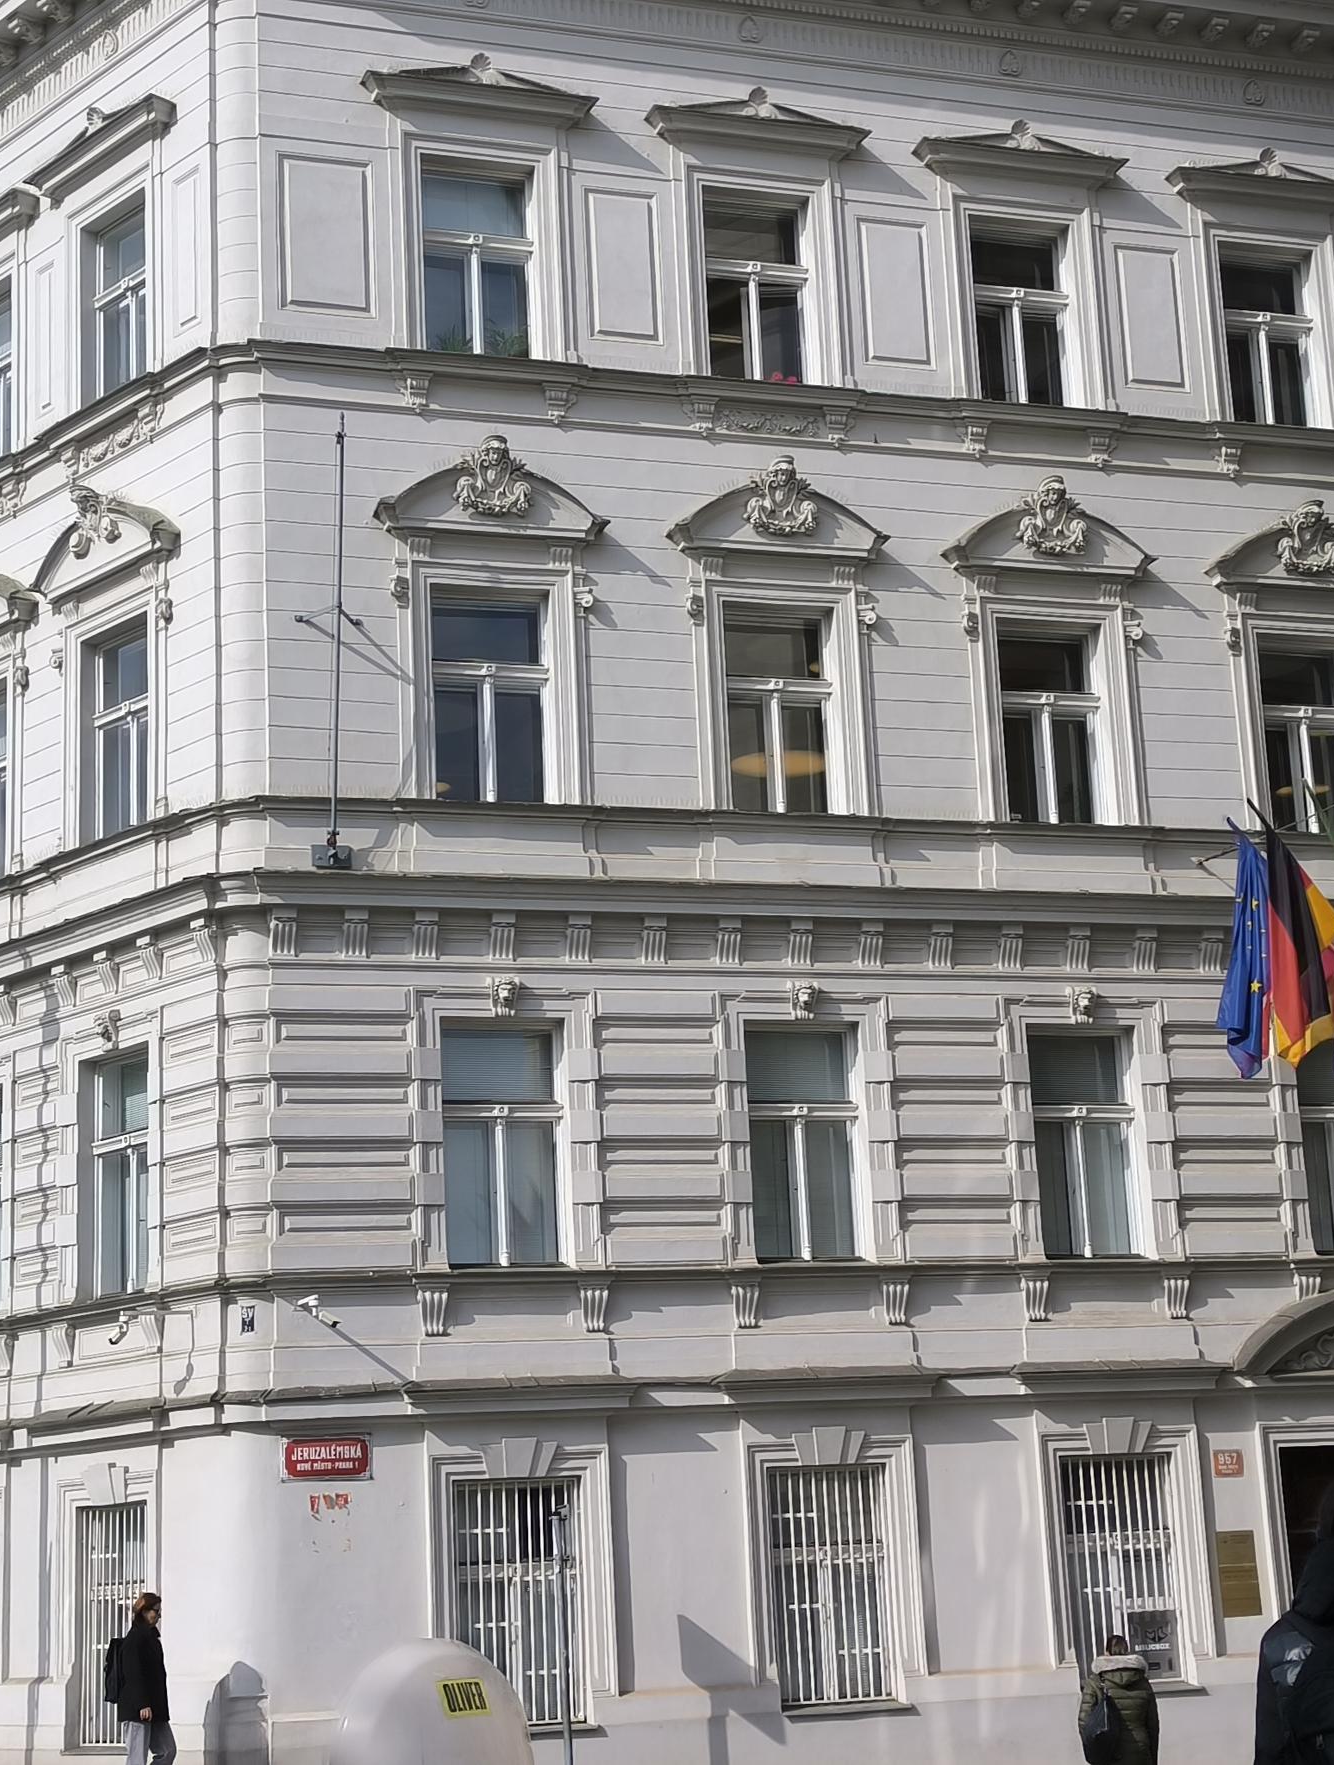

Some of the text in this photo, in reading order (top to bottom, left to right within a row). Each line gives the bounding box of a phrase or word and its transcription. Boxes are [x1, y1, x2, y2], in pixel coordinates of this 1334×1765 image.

[291, 1443, 362, 1460] JERUZALÉMSKÁ
[296, 1461, 312, 1471] NOVÉ
[443, 1681, 487, 1713] OLIVER
